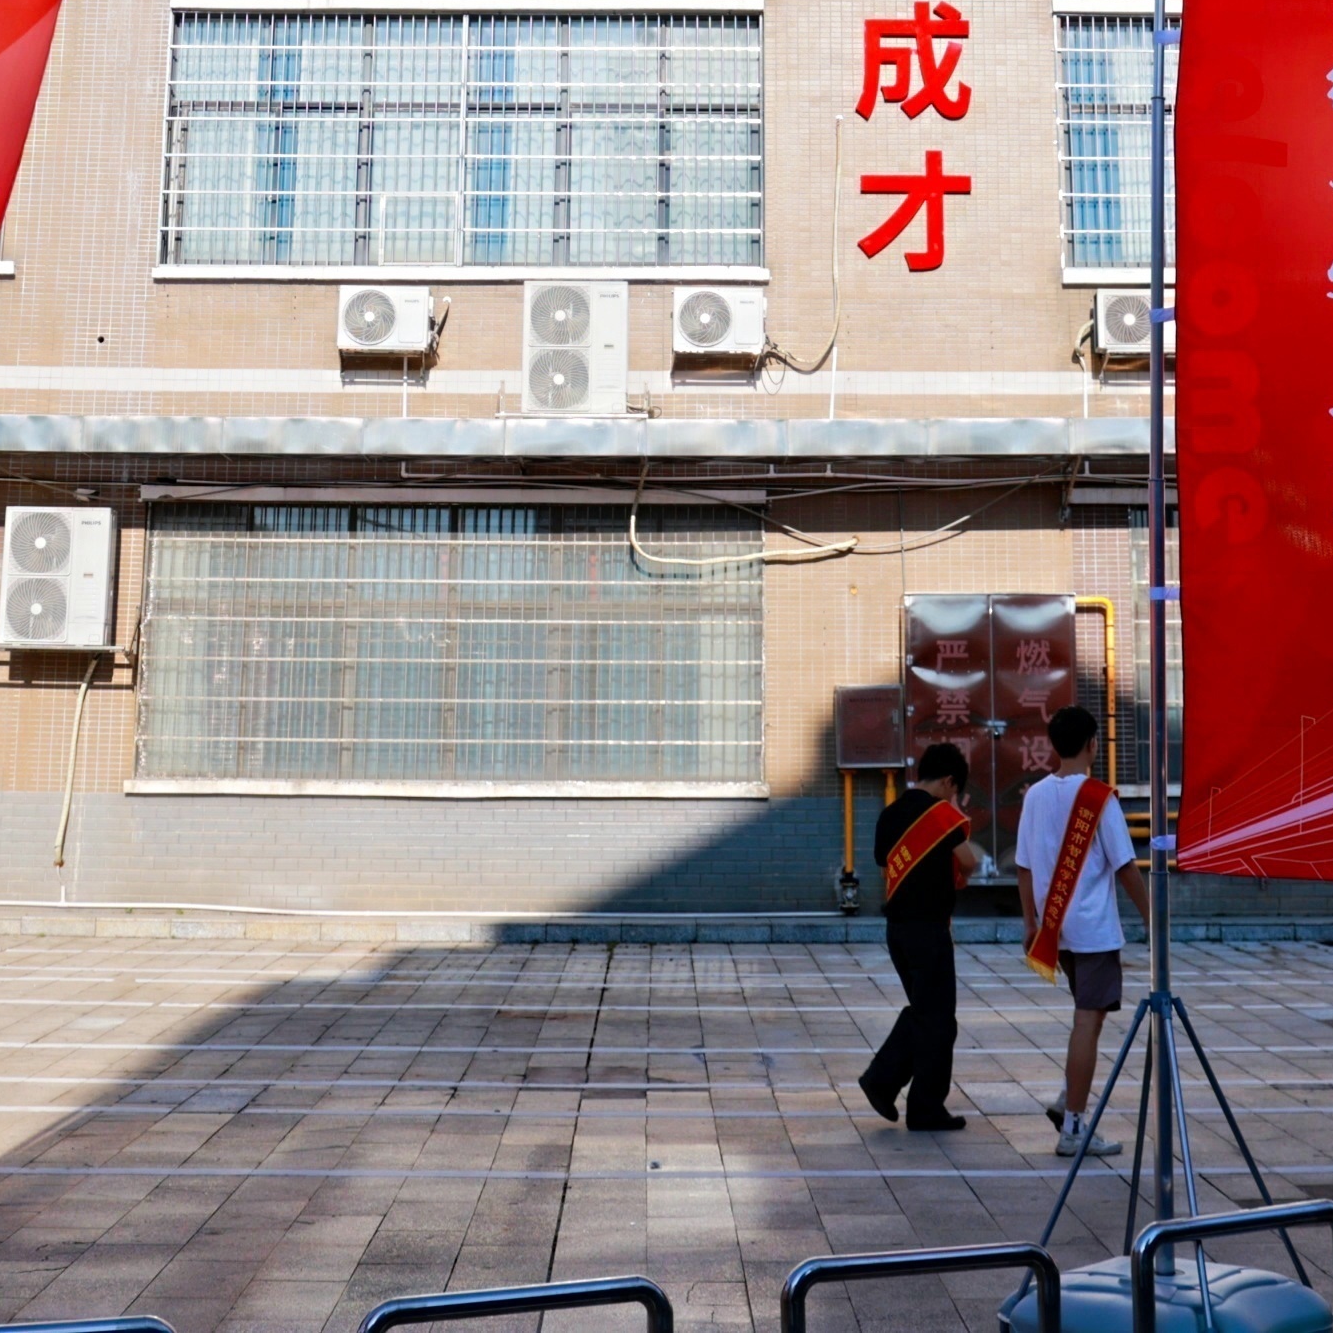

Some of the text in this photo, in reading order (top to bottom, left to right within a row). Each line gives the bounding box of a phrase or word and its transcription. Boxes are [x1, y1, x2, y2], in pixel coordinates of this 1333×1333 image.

[854, 0, 973, 273] 成才
[935, 639, 972, 807] 严禁
[1016, 639, 1055, 801] 燃气设
